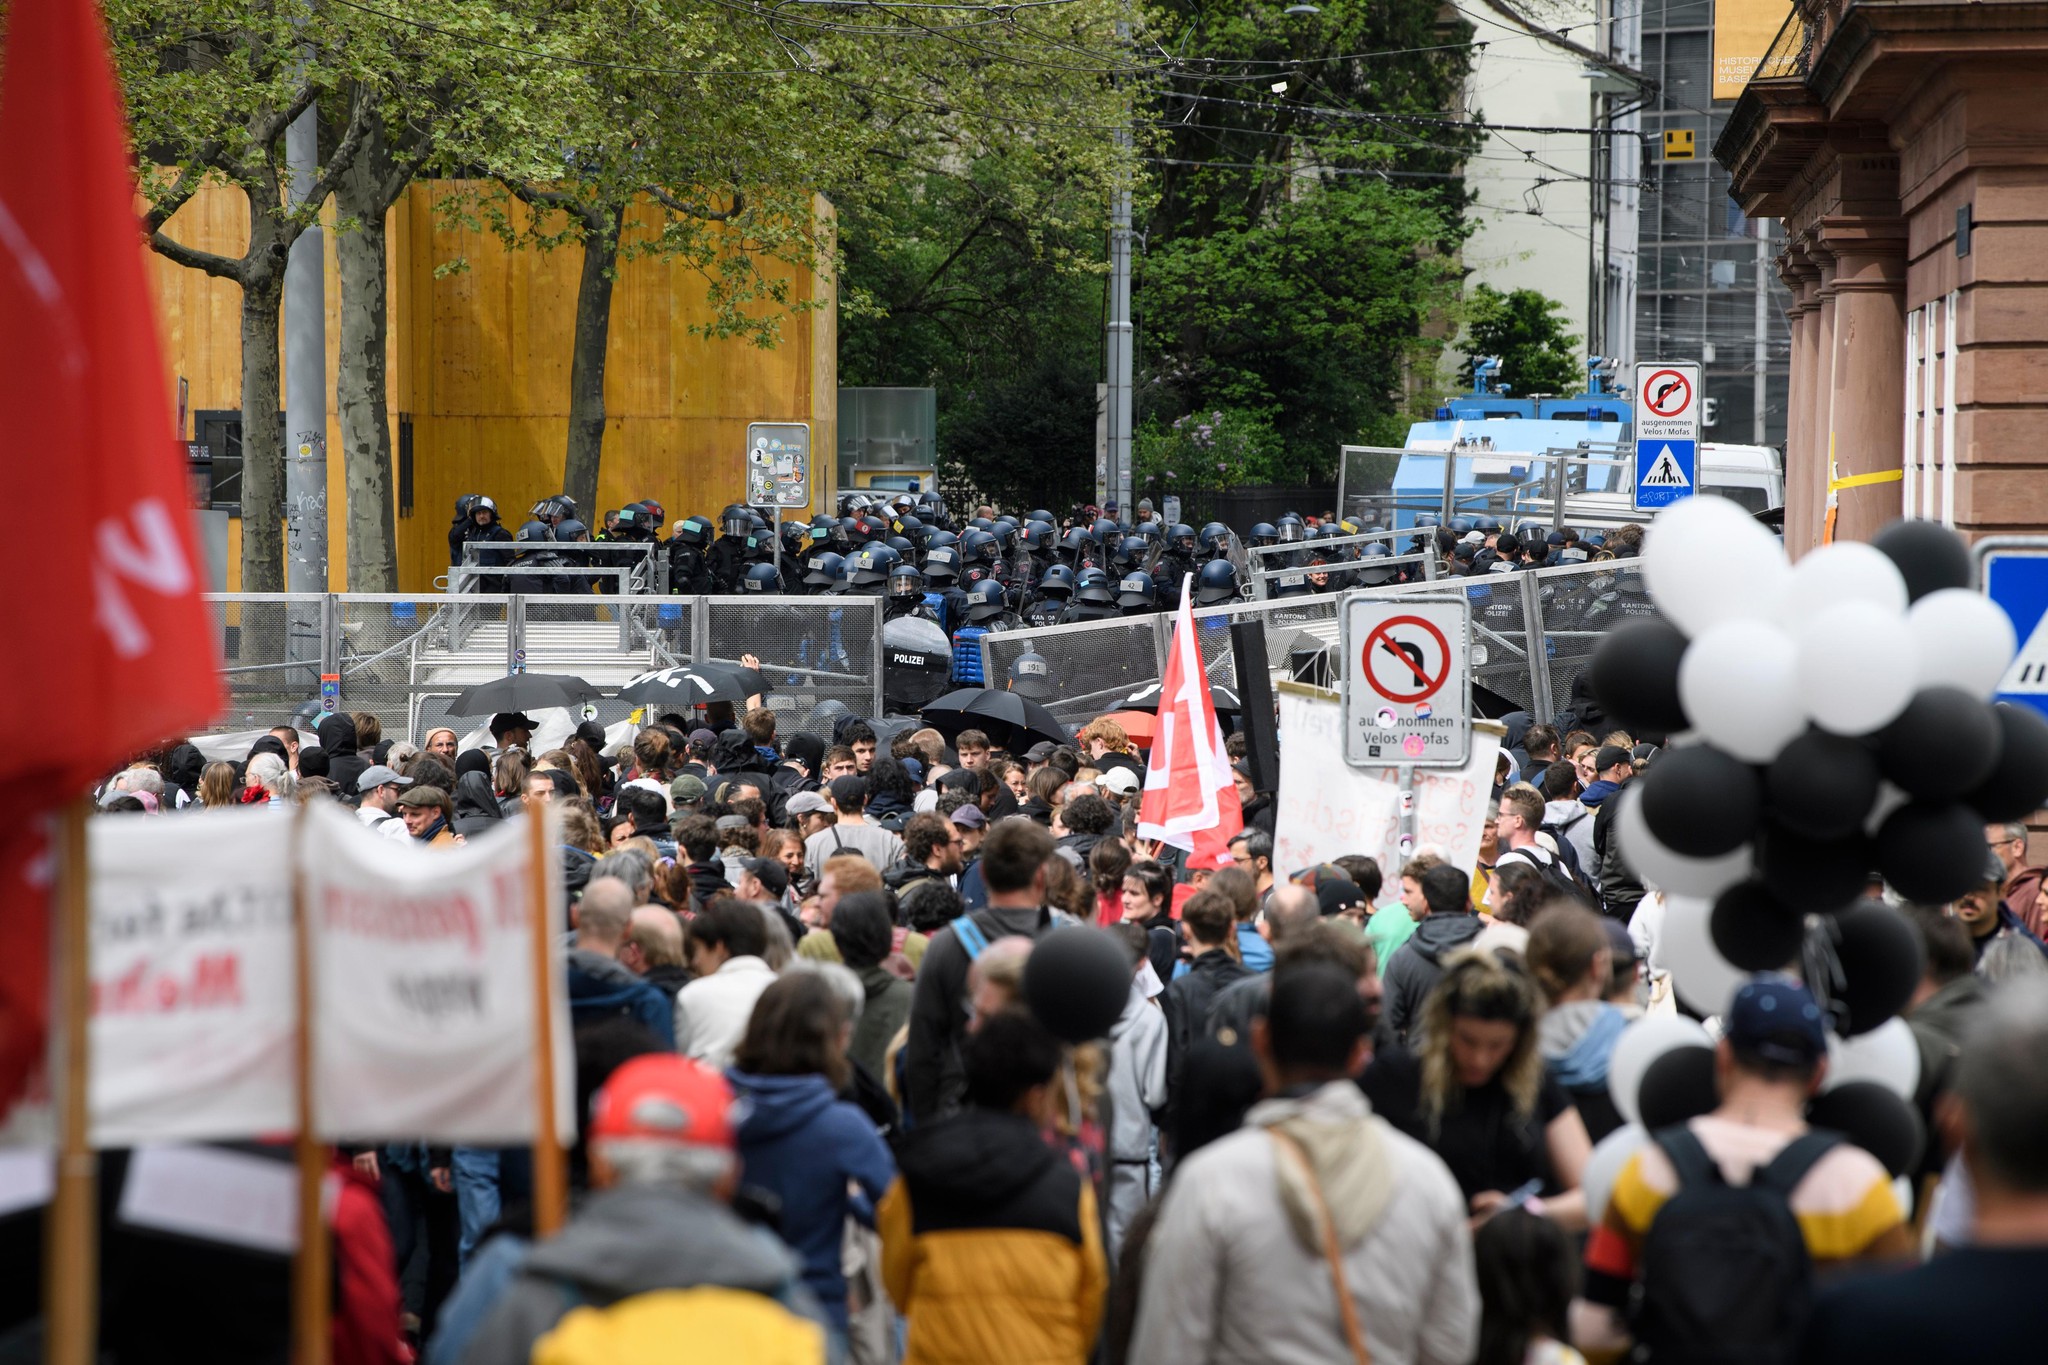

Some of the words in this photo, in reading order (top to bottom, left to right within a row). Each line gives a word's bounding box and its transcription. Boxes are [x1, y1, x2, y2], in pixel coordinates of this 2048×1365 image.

[1641, 419, 1693, 428] ausgenommen
[893, 653, 925, 666] POLIZEI
[1027, 663, 1040, 672] 191
[1359, 716, 1454, 730] aunommen
[1363, 732, 1398, 744] Velos
[1409, 732, 1450, 745] ofas
